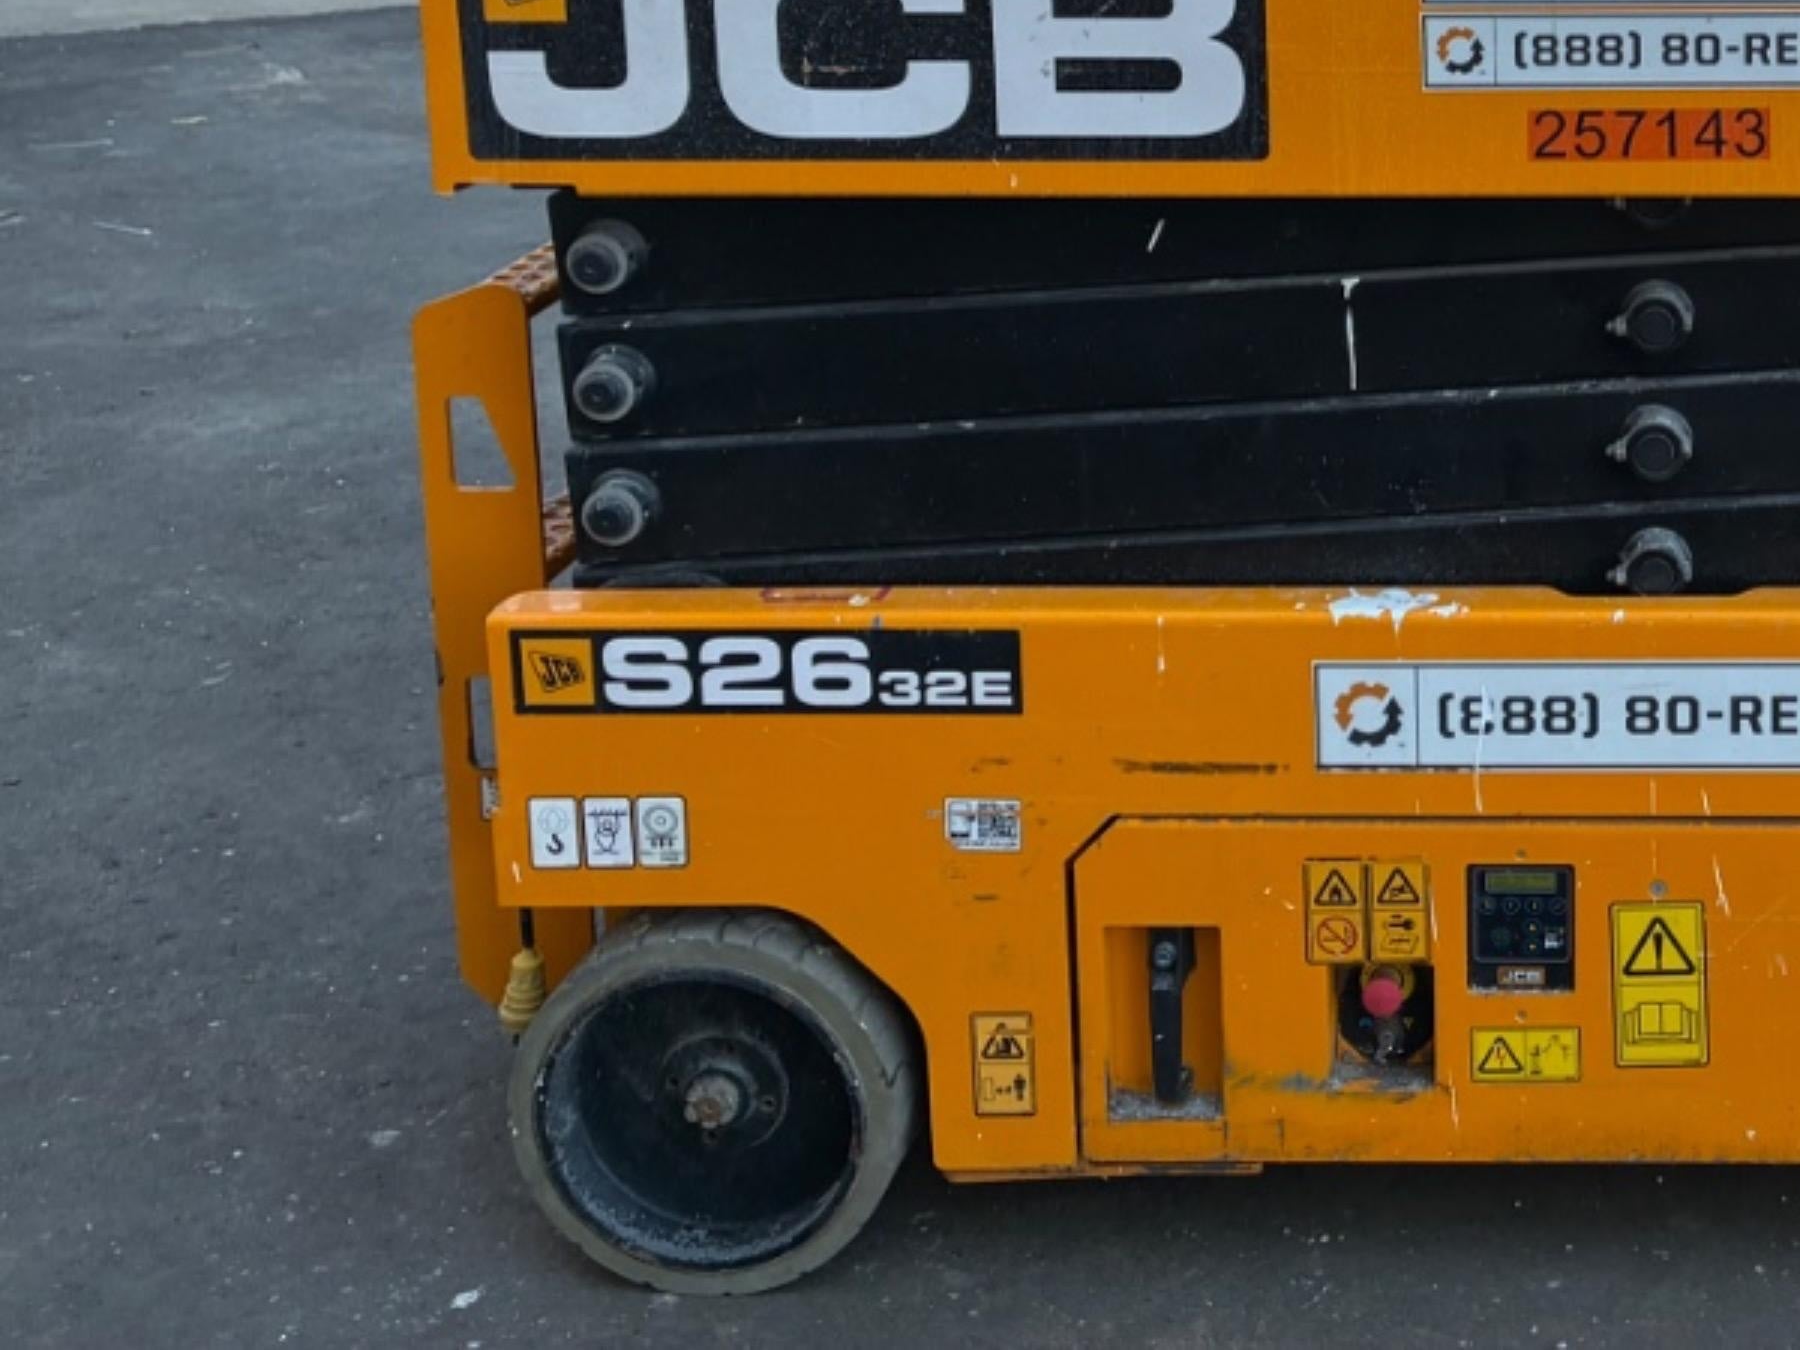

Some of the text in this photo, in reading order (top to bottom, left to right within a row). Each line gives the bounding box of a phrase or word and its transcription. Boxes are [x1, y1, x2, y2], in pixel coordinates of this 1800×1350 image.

[1514, 30, 1643, 69] (888)
[1533, 108, 1767, 159] 257143
[539, 653, 585, 688] JCB
[1438, 692, 1600, 738] (888)
